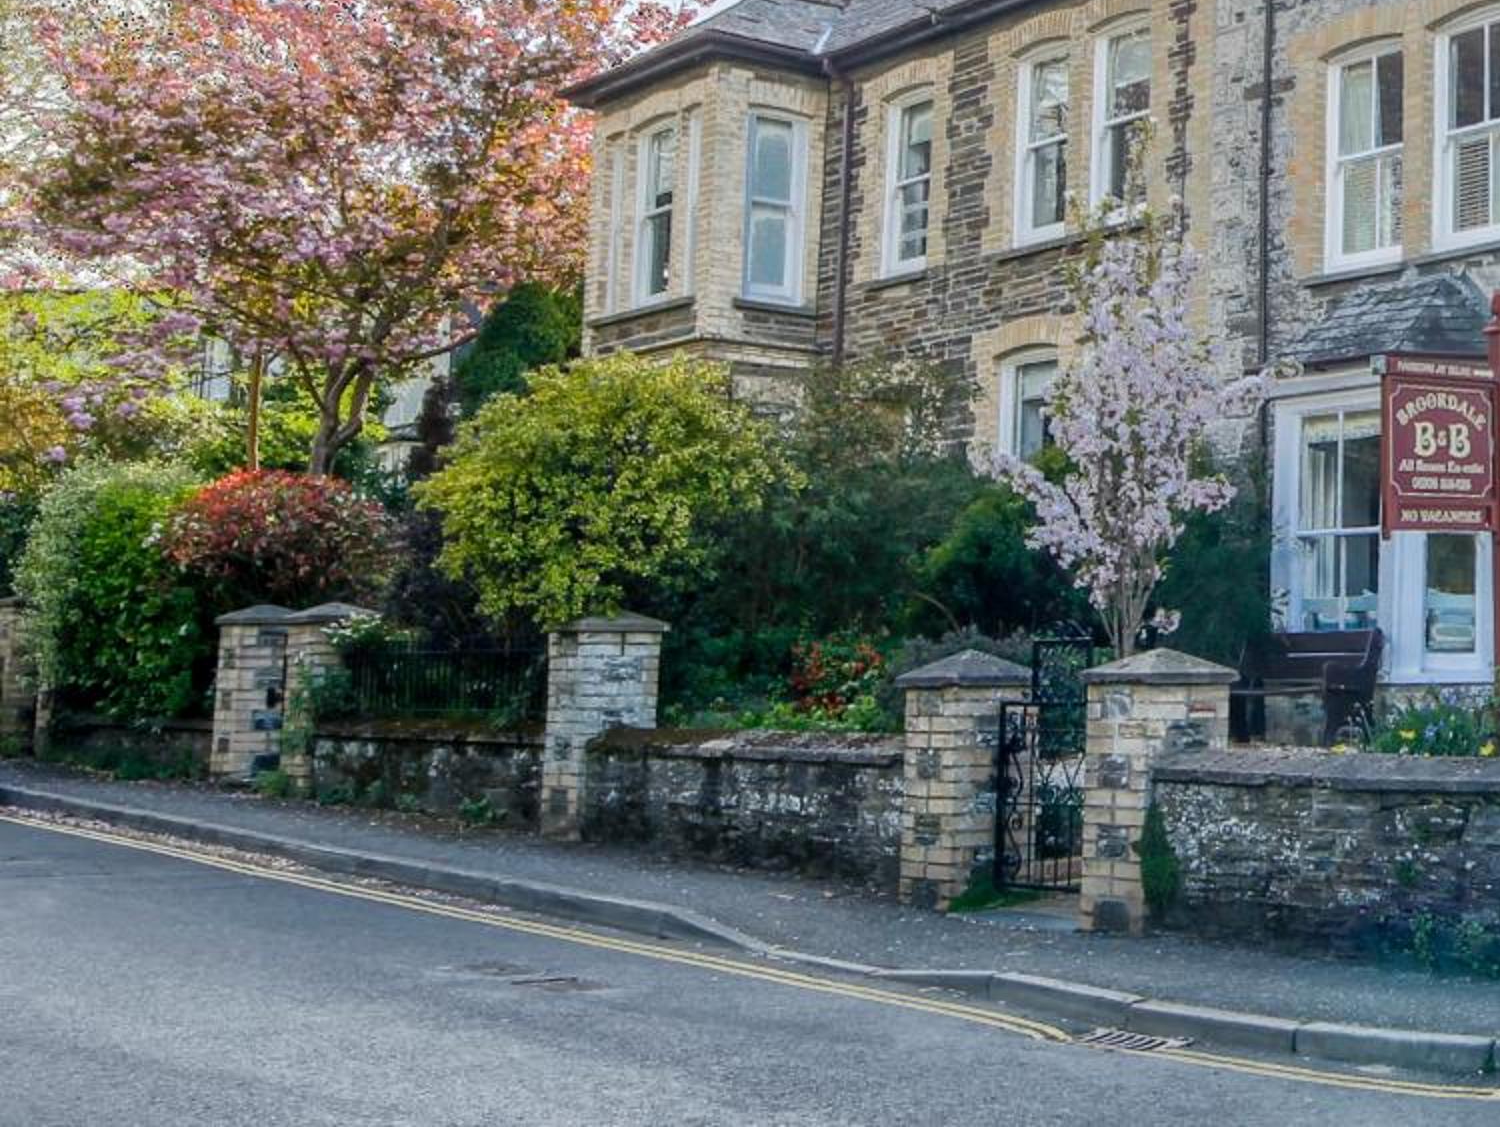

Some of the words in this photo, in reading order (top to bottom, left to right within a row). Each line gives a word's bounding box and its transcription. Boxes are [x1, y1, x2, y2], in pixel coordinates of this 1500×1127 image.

[1396, 392, 1486, 431] BROOKDALE
[1399, 459, 1414, 472] All
[1401, 509, 1418, 522] NO
